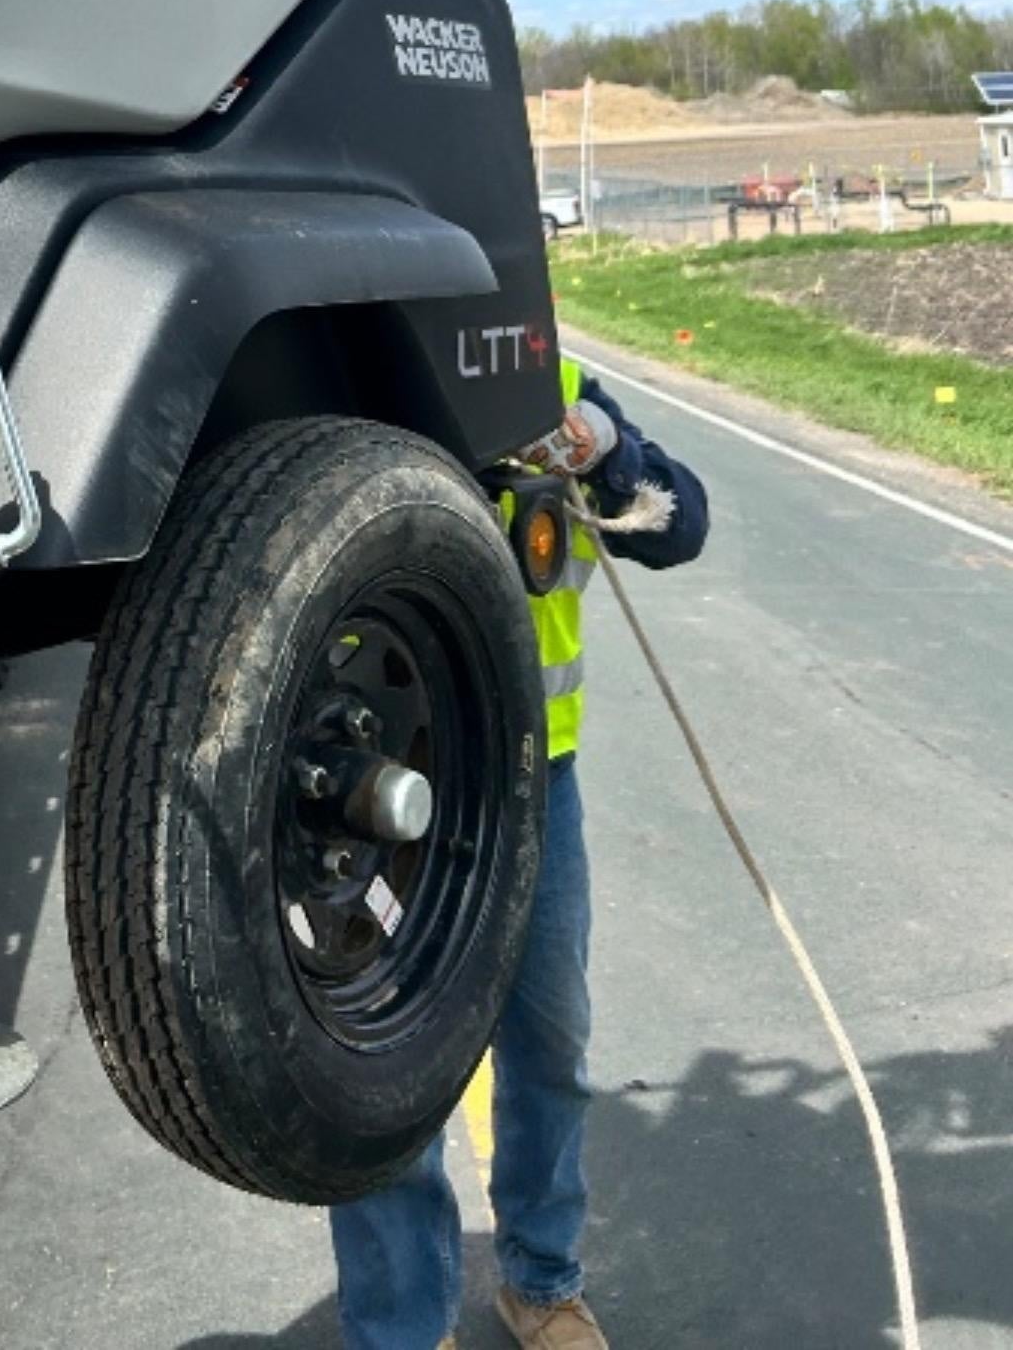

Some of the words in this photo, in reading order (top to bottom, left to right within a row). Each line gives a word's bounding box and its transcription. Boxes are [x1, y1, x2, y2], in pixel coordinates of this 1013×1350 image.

[386, 14, 485, 52] WACKER
[394, 44, 490, 82] NEUSON
[457, 323, 549, 377] LTT4
